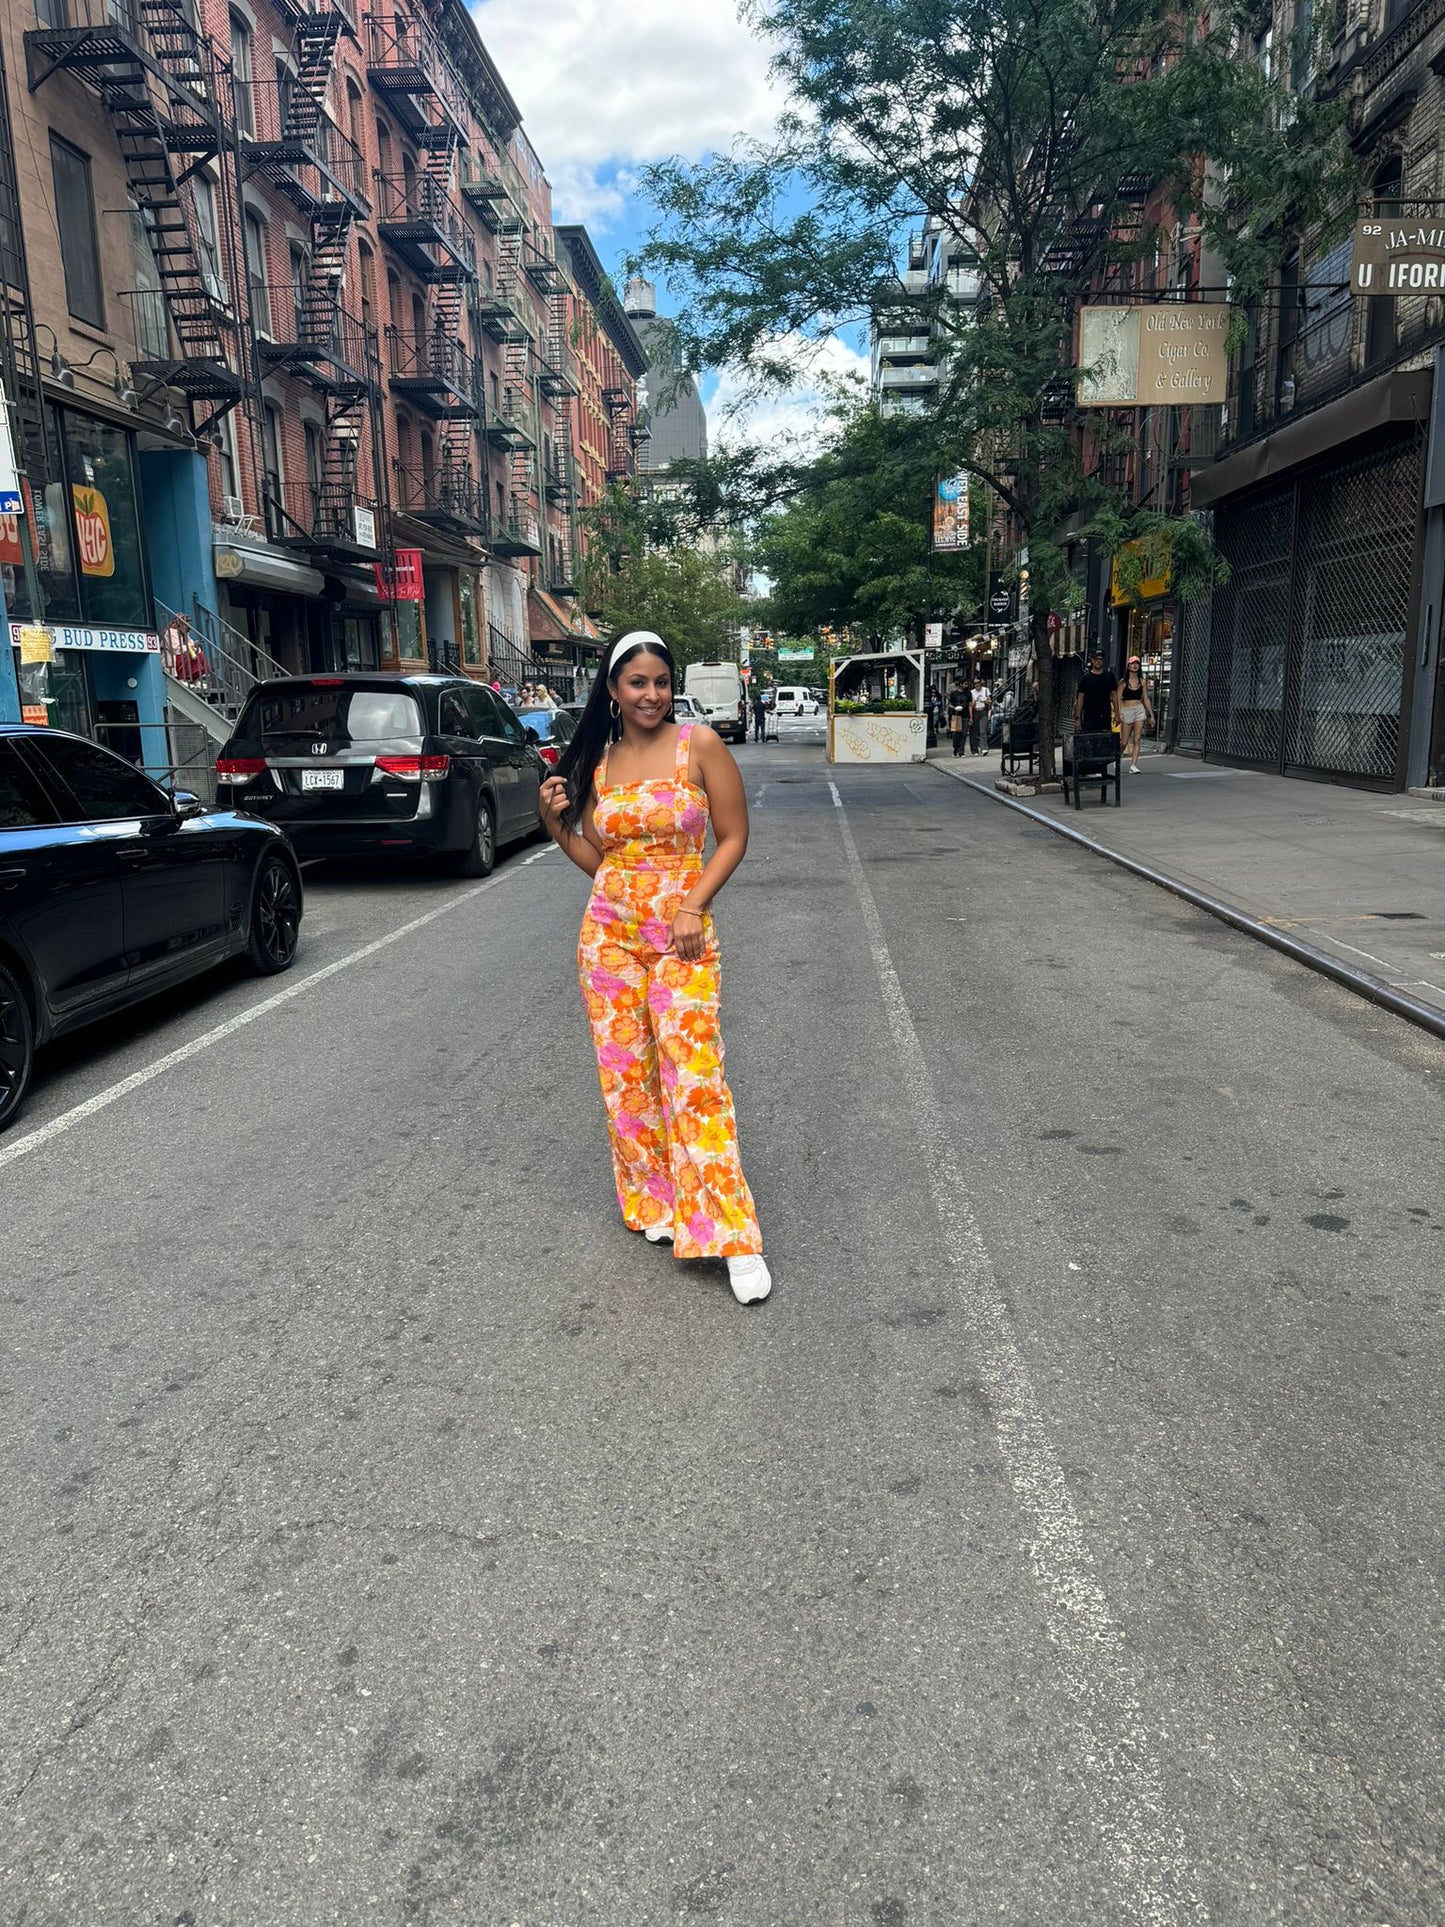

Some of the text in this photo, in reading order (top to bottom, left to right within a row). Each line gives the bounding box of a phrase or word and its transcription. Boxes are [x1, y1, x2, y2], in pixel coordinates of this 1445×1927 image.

[1362, 225, 1382, 235] 92
[1385, 228, 1445, 250] JA-MI
[1358, 263, 1445, 288] UIFOR
[1146, 310, 1226, 332] Old New York
[1159, 340, 1210, 366] Cigar Co.
[1155, 368, 1213, 396] & Gallery
[957, 496, 968, 520] EAST
[956, 524, 968, 546] SIDE
[13, 626, 21, 642] 9
[63, 629, 93, 647] BUD
[100, 631, 145, 650] PRESS
[148, 635, 157, 649] 93
